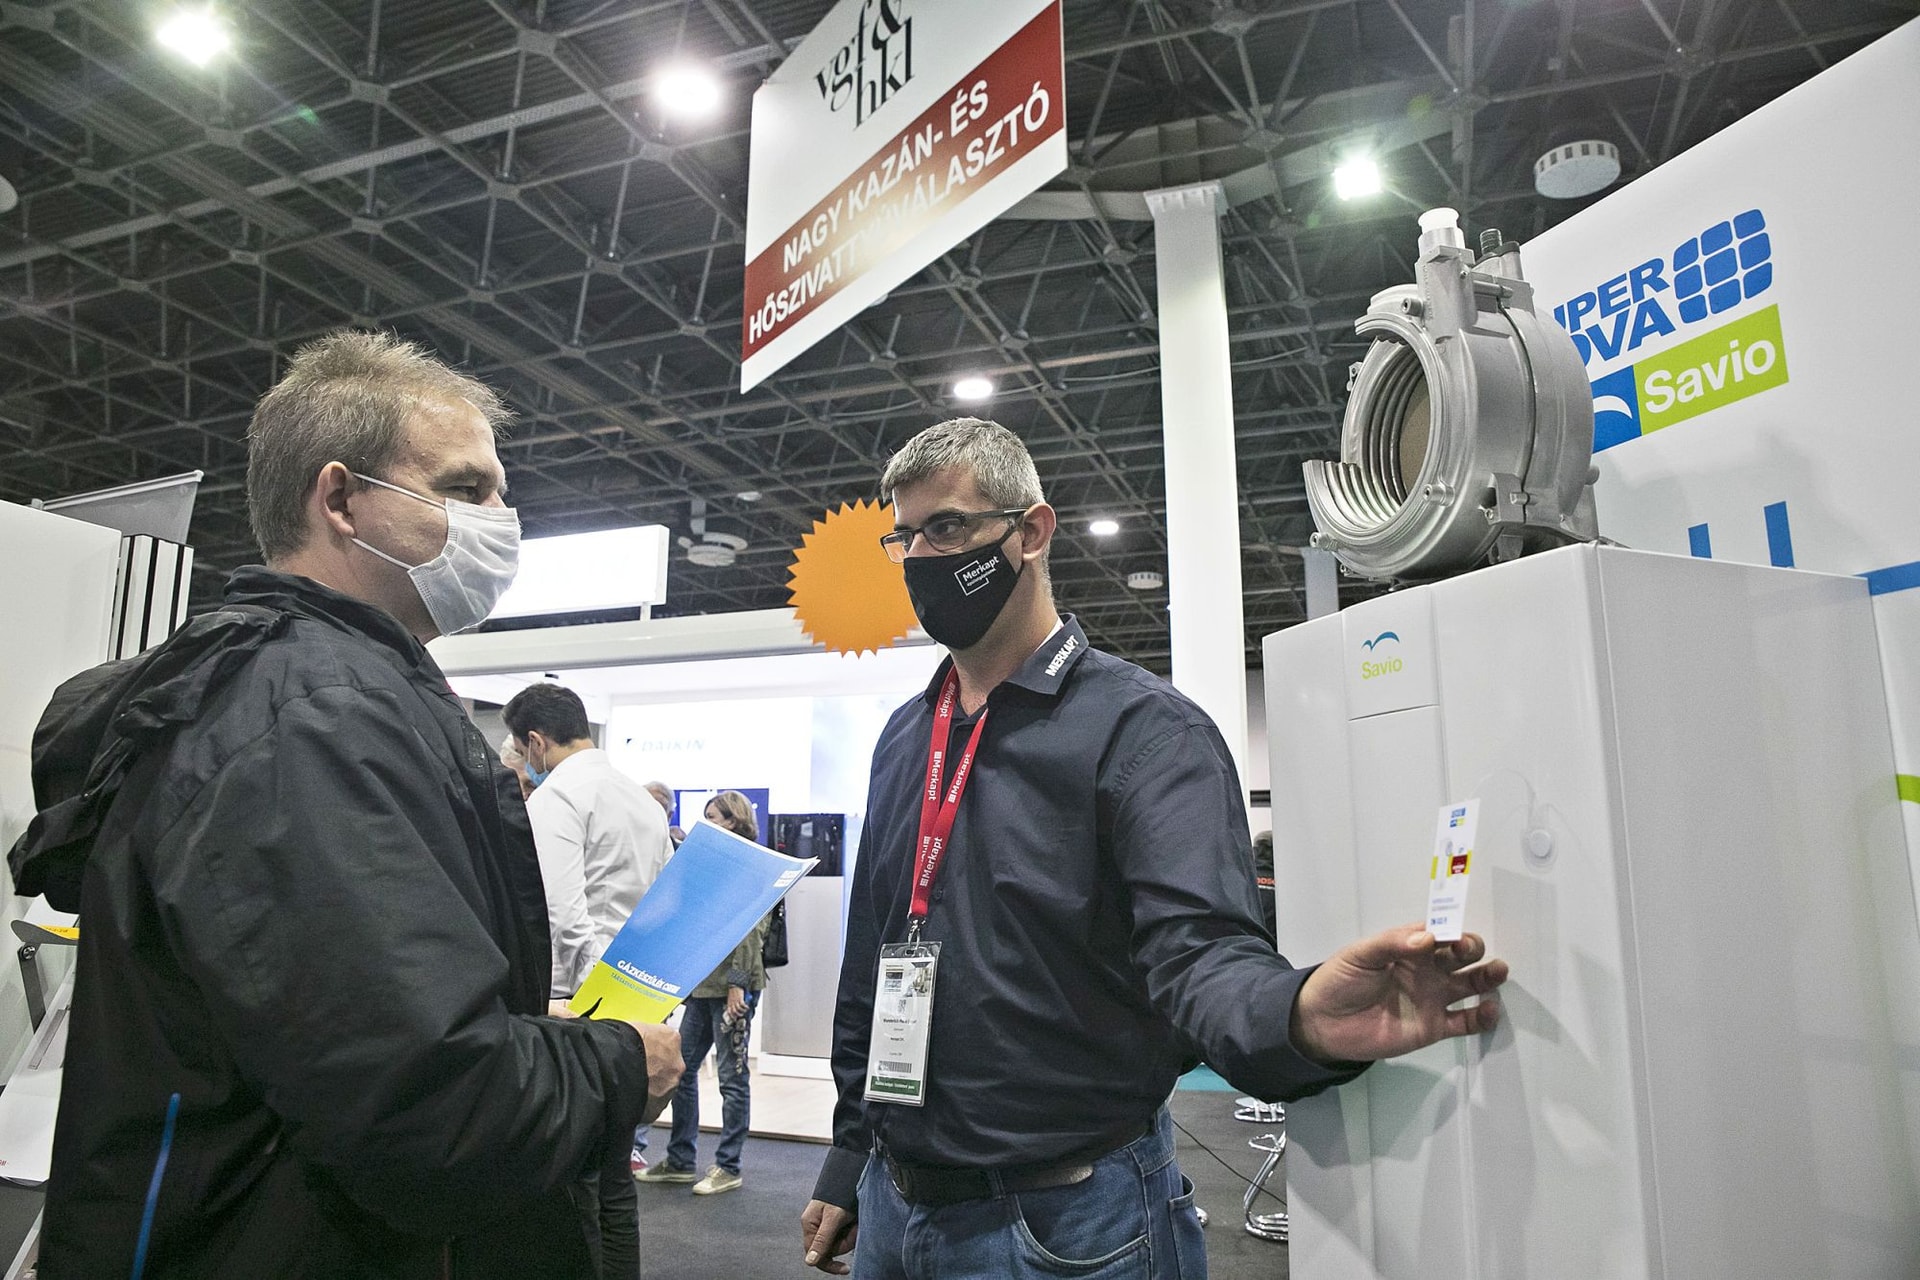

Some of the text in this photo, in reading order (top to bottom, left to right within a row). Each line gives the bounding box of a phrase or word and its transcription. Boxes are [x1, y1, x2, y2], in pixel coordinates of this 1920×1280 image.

[783, 79, 989, 273] NAGY KAZÁN- ÉS
[1643, 339, 1776, 414] Savio
[962, 556, 999, 582] Merkapt
[1045, 635, 1079, 677] MERKAPT
[1361, 655, 1403, 680] Savio
[928, 760, 941, 801] Merkapt
[951, 753, 971, 795] Merkapt
[922, 836, 943, 880] Merkapt
